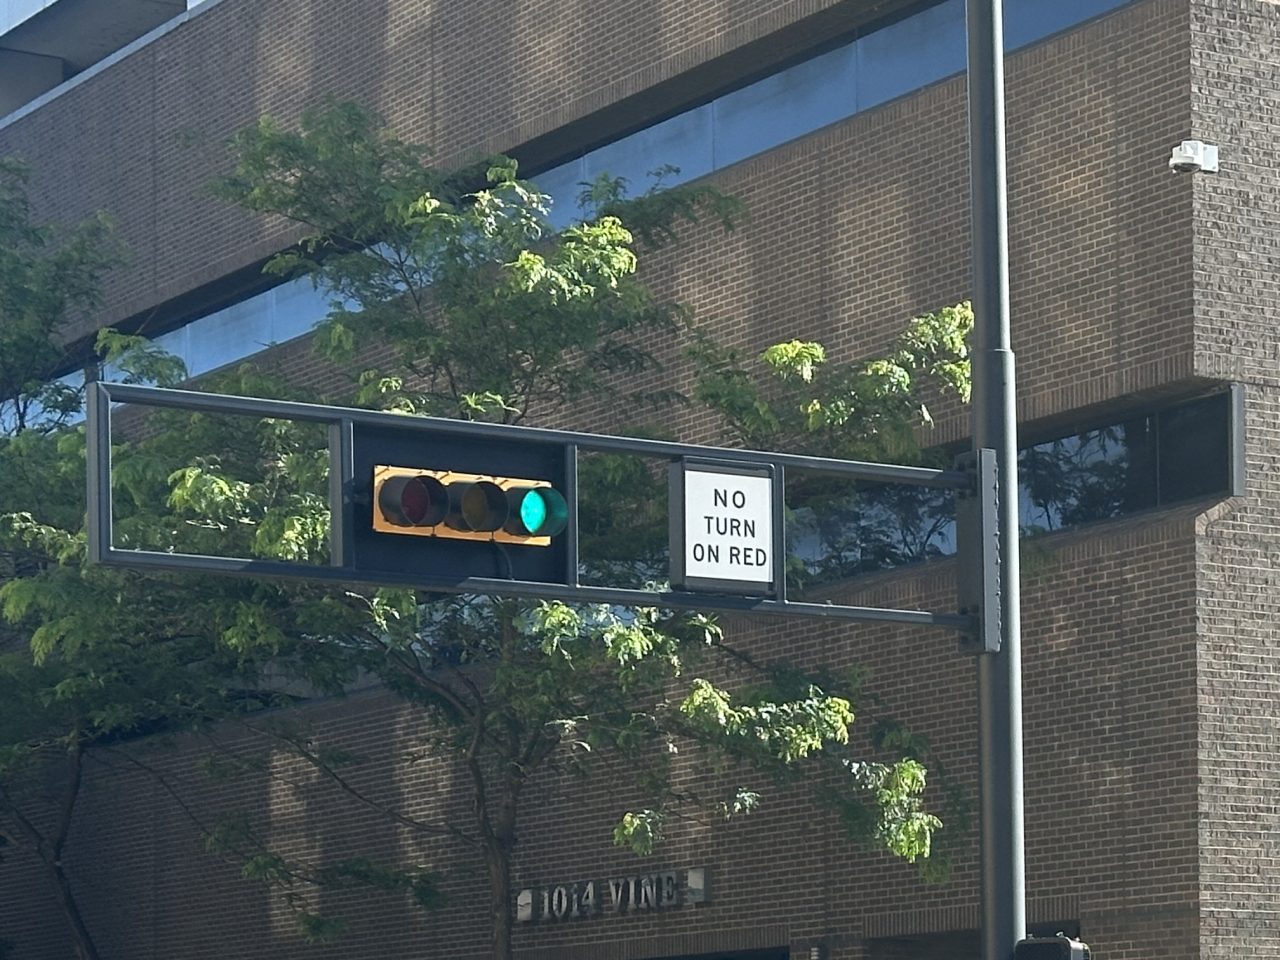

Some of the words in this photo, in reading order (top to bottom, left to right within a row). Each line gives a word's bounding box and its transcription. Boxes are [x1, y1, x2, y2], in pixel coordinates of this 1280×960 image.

[714, 488, 746, 509] NO
[703, 515, 755, 538] TURN
[693, 543, 719, 563] ON
[729, 546, 767, 567] RED
[541, 881, 596, 919] 1014
[608, 871, 678, 911] VINE
